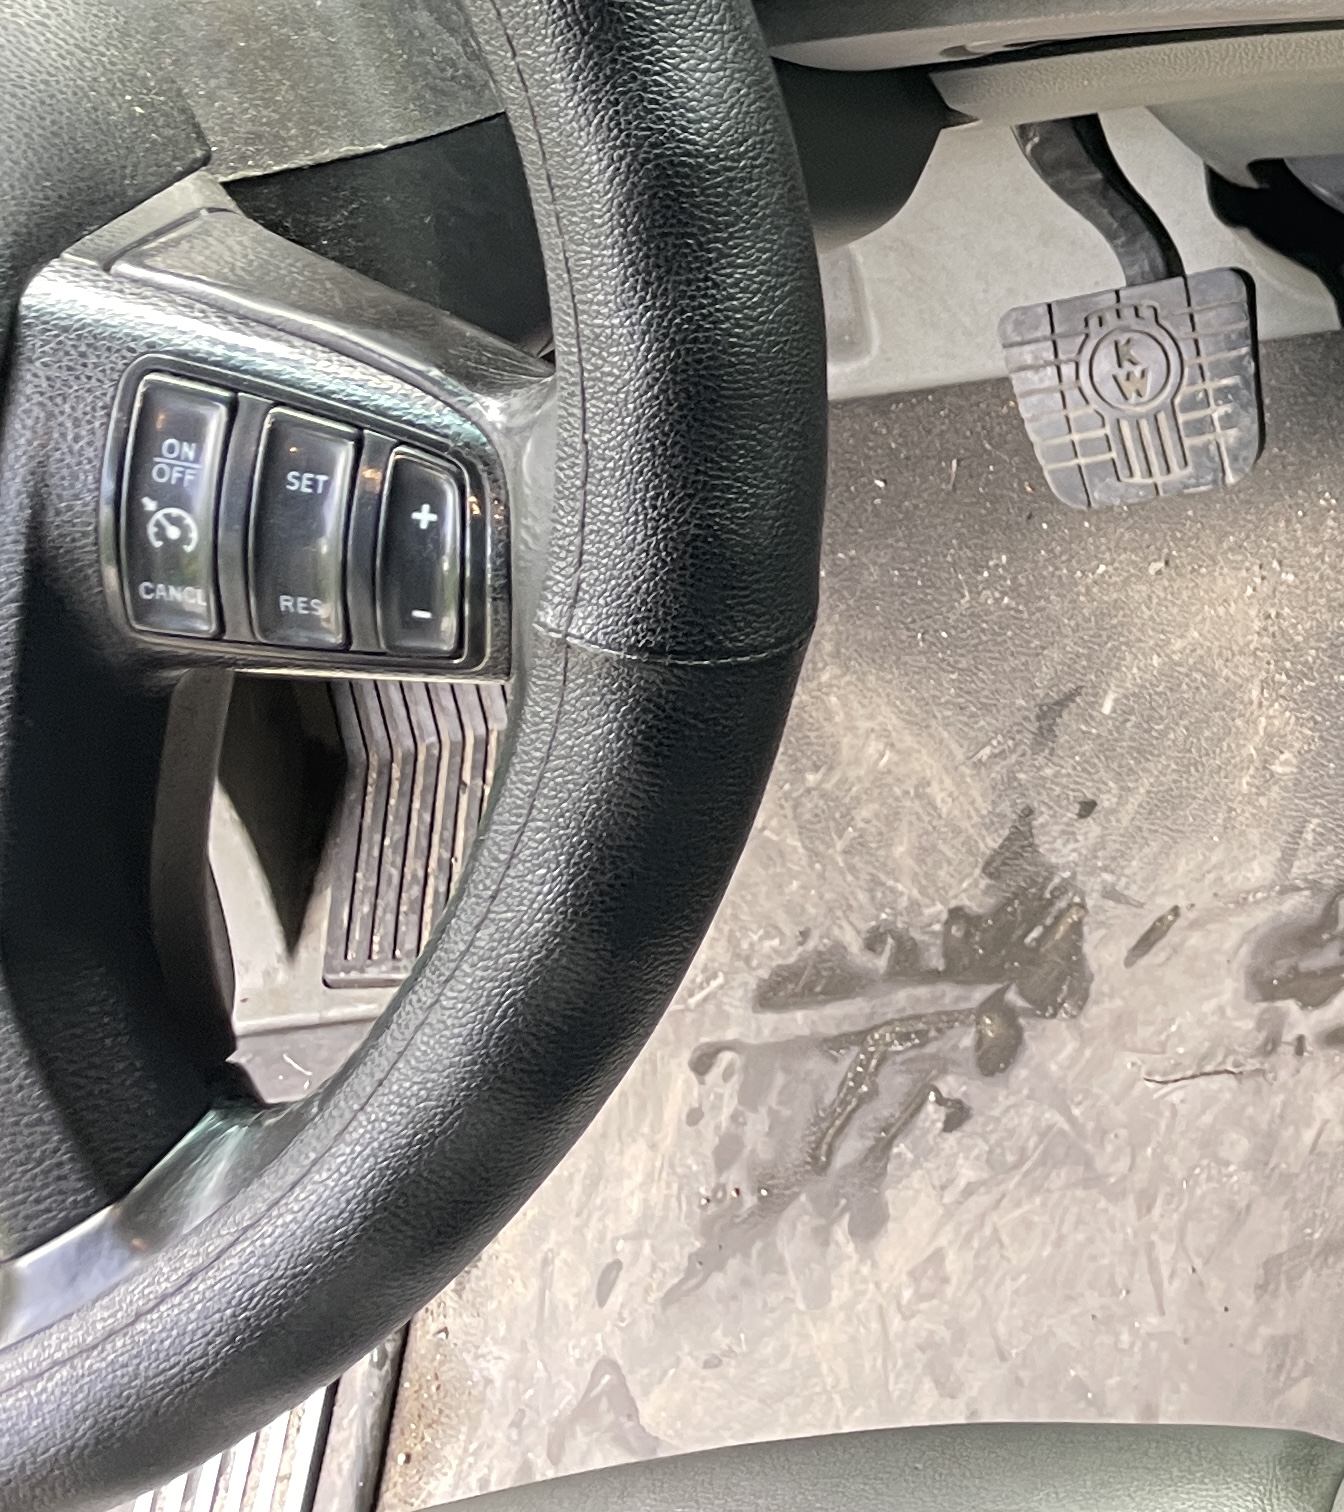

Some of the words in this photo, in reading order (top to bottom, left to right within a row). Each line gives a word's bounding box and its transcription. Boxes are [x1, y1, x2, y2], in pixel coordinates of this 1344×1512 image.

[161, 438, 197, 462] ON
[151, 463, 198, 487] OFF
[285, 471, 330, 495] SET
[279, 594, 324, 617] RES
